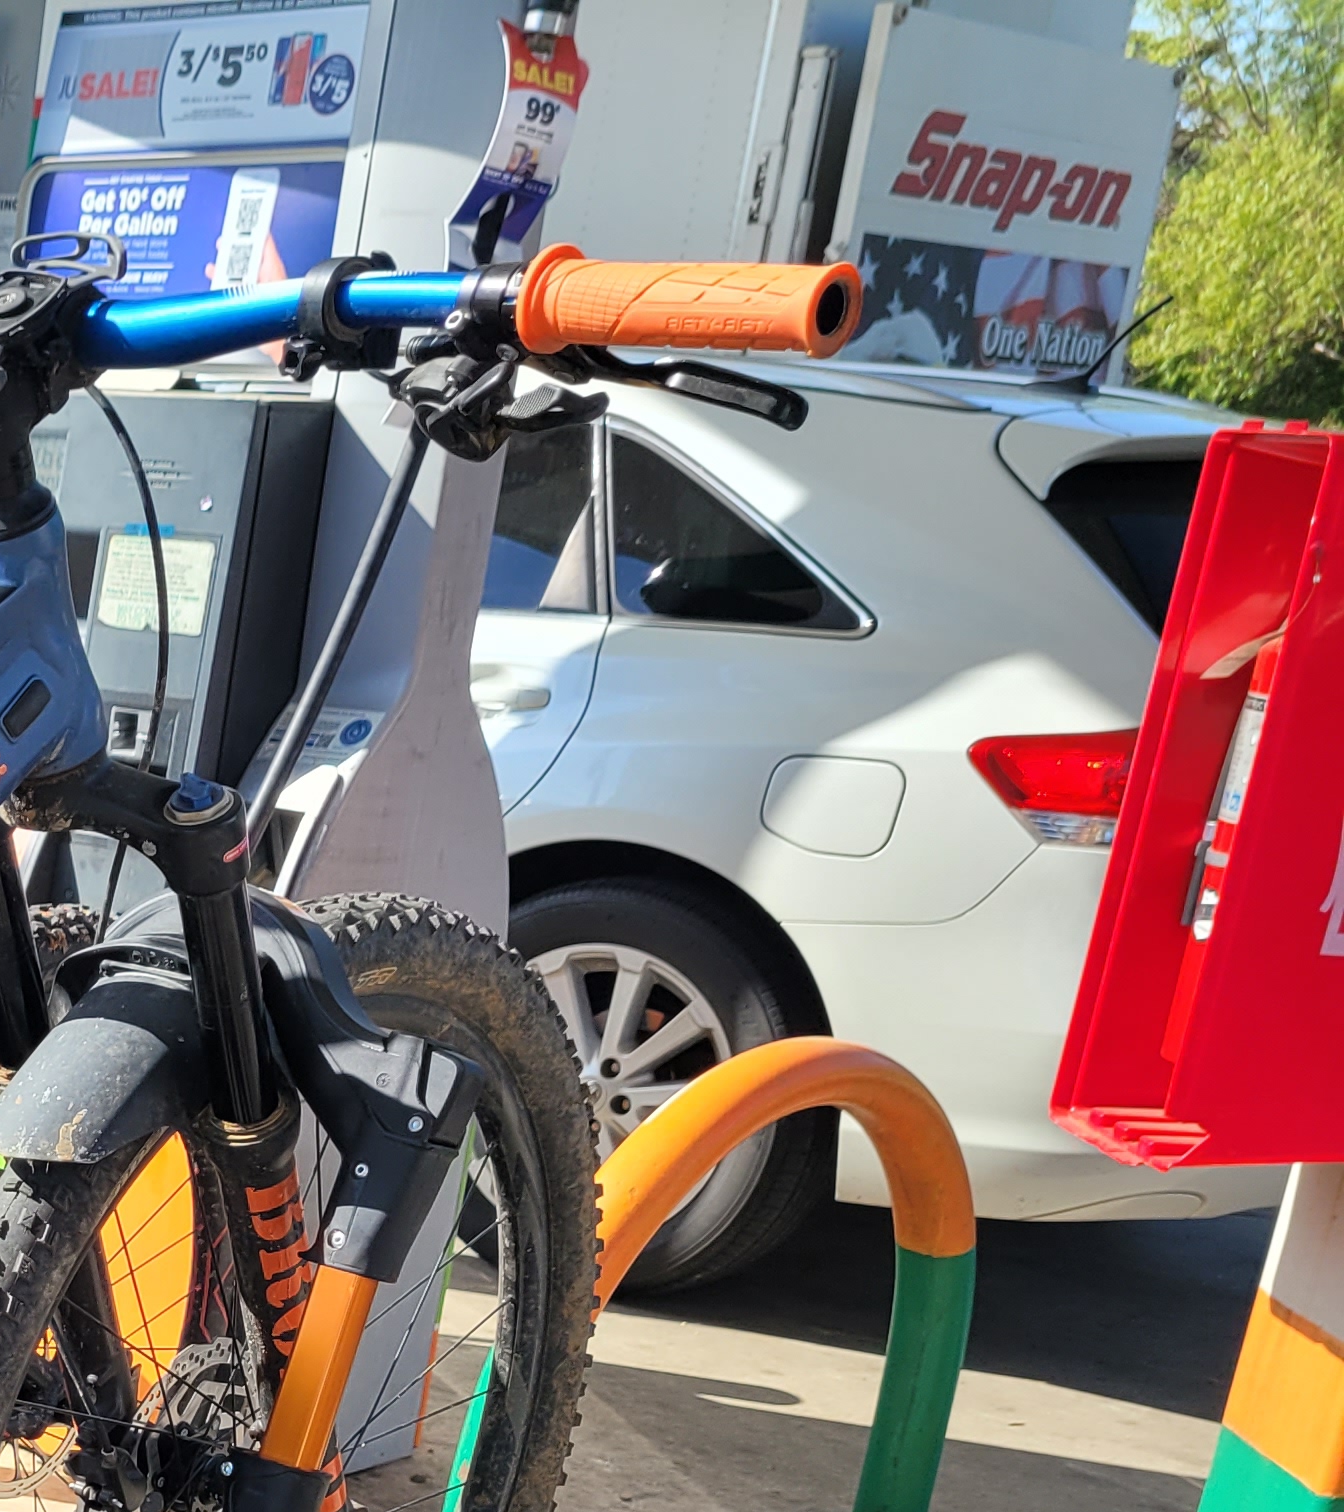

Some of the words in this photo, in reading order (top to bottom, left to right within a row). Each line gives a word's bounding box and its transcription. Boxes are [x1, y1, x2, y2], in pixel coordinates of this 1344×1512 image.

[78, 67, 159, 103] SALE!
[512, 59, 576, 96] SALE!
[890, 109, 1132, 232] Snap-on
[80, 189, 117, 214] Get
[150, 184, 187, 211] Off
[113, 211, 179, 236] Gallon
[980, 317, 1026, 364] One
[1030, 319, 1106, 369] Nation
